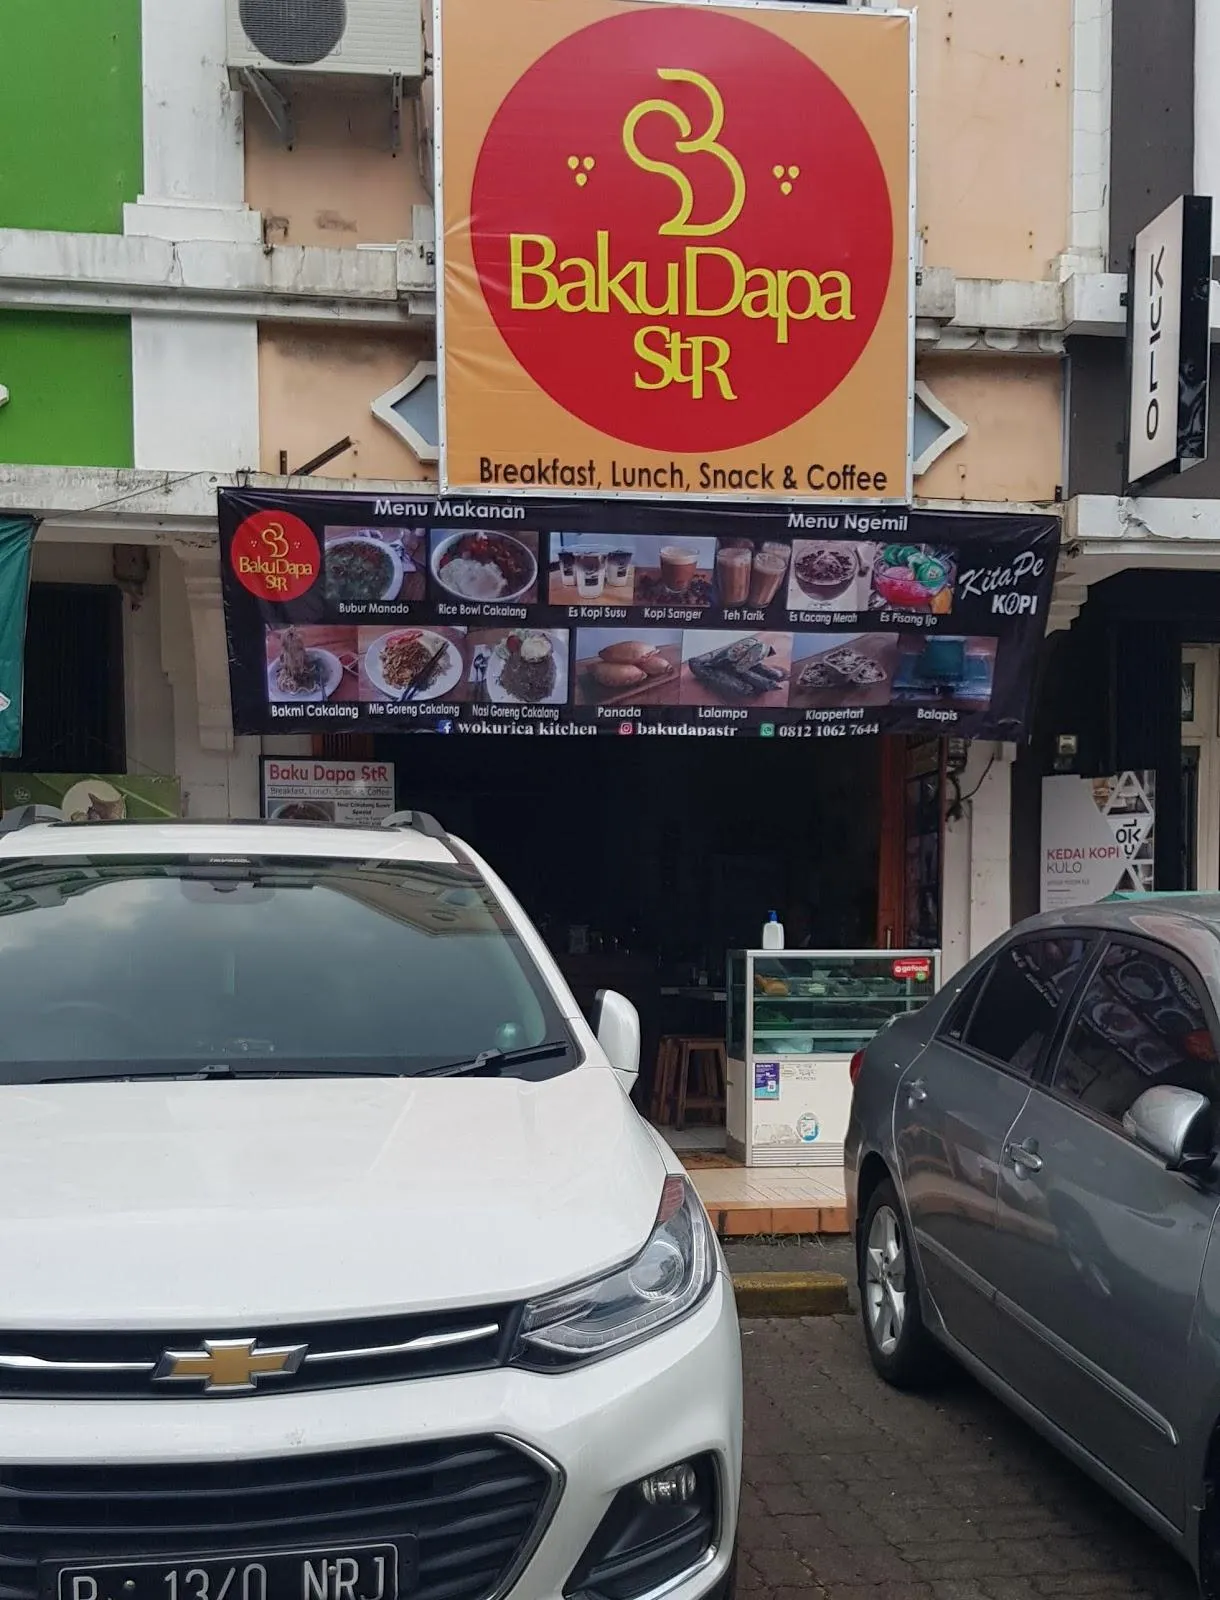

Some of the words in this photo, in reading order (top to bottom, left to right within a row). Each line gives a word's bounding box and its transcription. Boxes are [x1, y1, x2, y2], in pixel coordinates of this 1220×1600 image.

[633, 325, 738, 401] StR
[479, 456, 602, 490] Breakfast,
[611, 460, 690, 492] Lunch,
[700, 462, 775, 489] Snack
[783, 464, 798, 490] &
[807, 463, 888, 491] Coffee
[374, 499, 428, 517] Menu
[433, 500, 526, 519] Makanan
[787, 513, 839, 530] Menu
[843, 513, 909, 533] Ngemil
[265, 574, 289, 591] StR
[339, 602, 367, 614] Bubur
[368, 603, 410, 614] Manado
[438, 603, 458, 615] Rice
[459, 604, 481, 616] Bowl
[482, 604, 528, 619] Cakalang
[991, 592, 1039, 615] KOPI
[568, 606, 579, 618] Es
[580, 606, 603, 620] Kopi
[604, 607, 627, 618] Susu
[643, 607, 666, 620] Kopi
[667, 608, 703, 621] Sanger
[723, 609, 741, 620] Teh
[742, 610, 765, 621] Tarik
[789, 611, 798, 622] Es
[799, 612, 832, 625] Kacang
[832, 612, 858, 623] Merah
[880, 612, 890, 622] Es
[892, 612, 924, 626] Pisang
[271, 704, 304, 717] Bakmi
[306, 704, 359, 719] Cakalang
[369, 703, 384, 715] Mie
[386, 703, 418, 717] Goreng
[419, 703, 460, 717] Cakalang
[472, 704, 489, 716] Nasi
[490, 705, 520, 720] Goreng
[521, 706, 560, 721] Cakalang
[597, 706, 642, 718] Panada
[698, 706, 749, 720] Lalampa
[805, 707, 865, 722] Klappertart
[917, 708, 958, 722] Balapis
[458, 720, 534, 736] wokurica
[538, 721, 598, 736] kitchen
[637, 722, 738, 737] bakudapastr
[779, 725, 812, 738] 0812
[816, 724, 847, 737] 1062
[850, 723, 880, 736] 7644
[269, 763, 309, 781] Baku
[313, 764, 356, 785] Dapa
[361, 765, 388, 782] StR
[1046, 848, 1085, 860] KEDAI
[1088, 846, 1119, 859] KOPI
[1046, 860, 1082, 874] KULO
